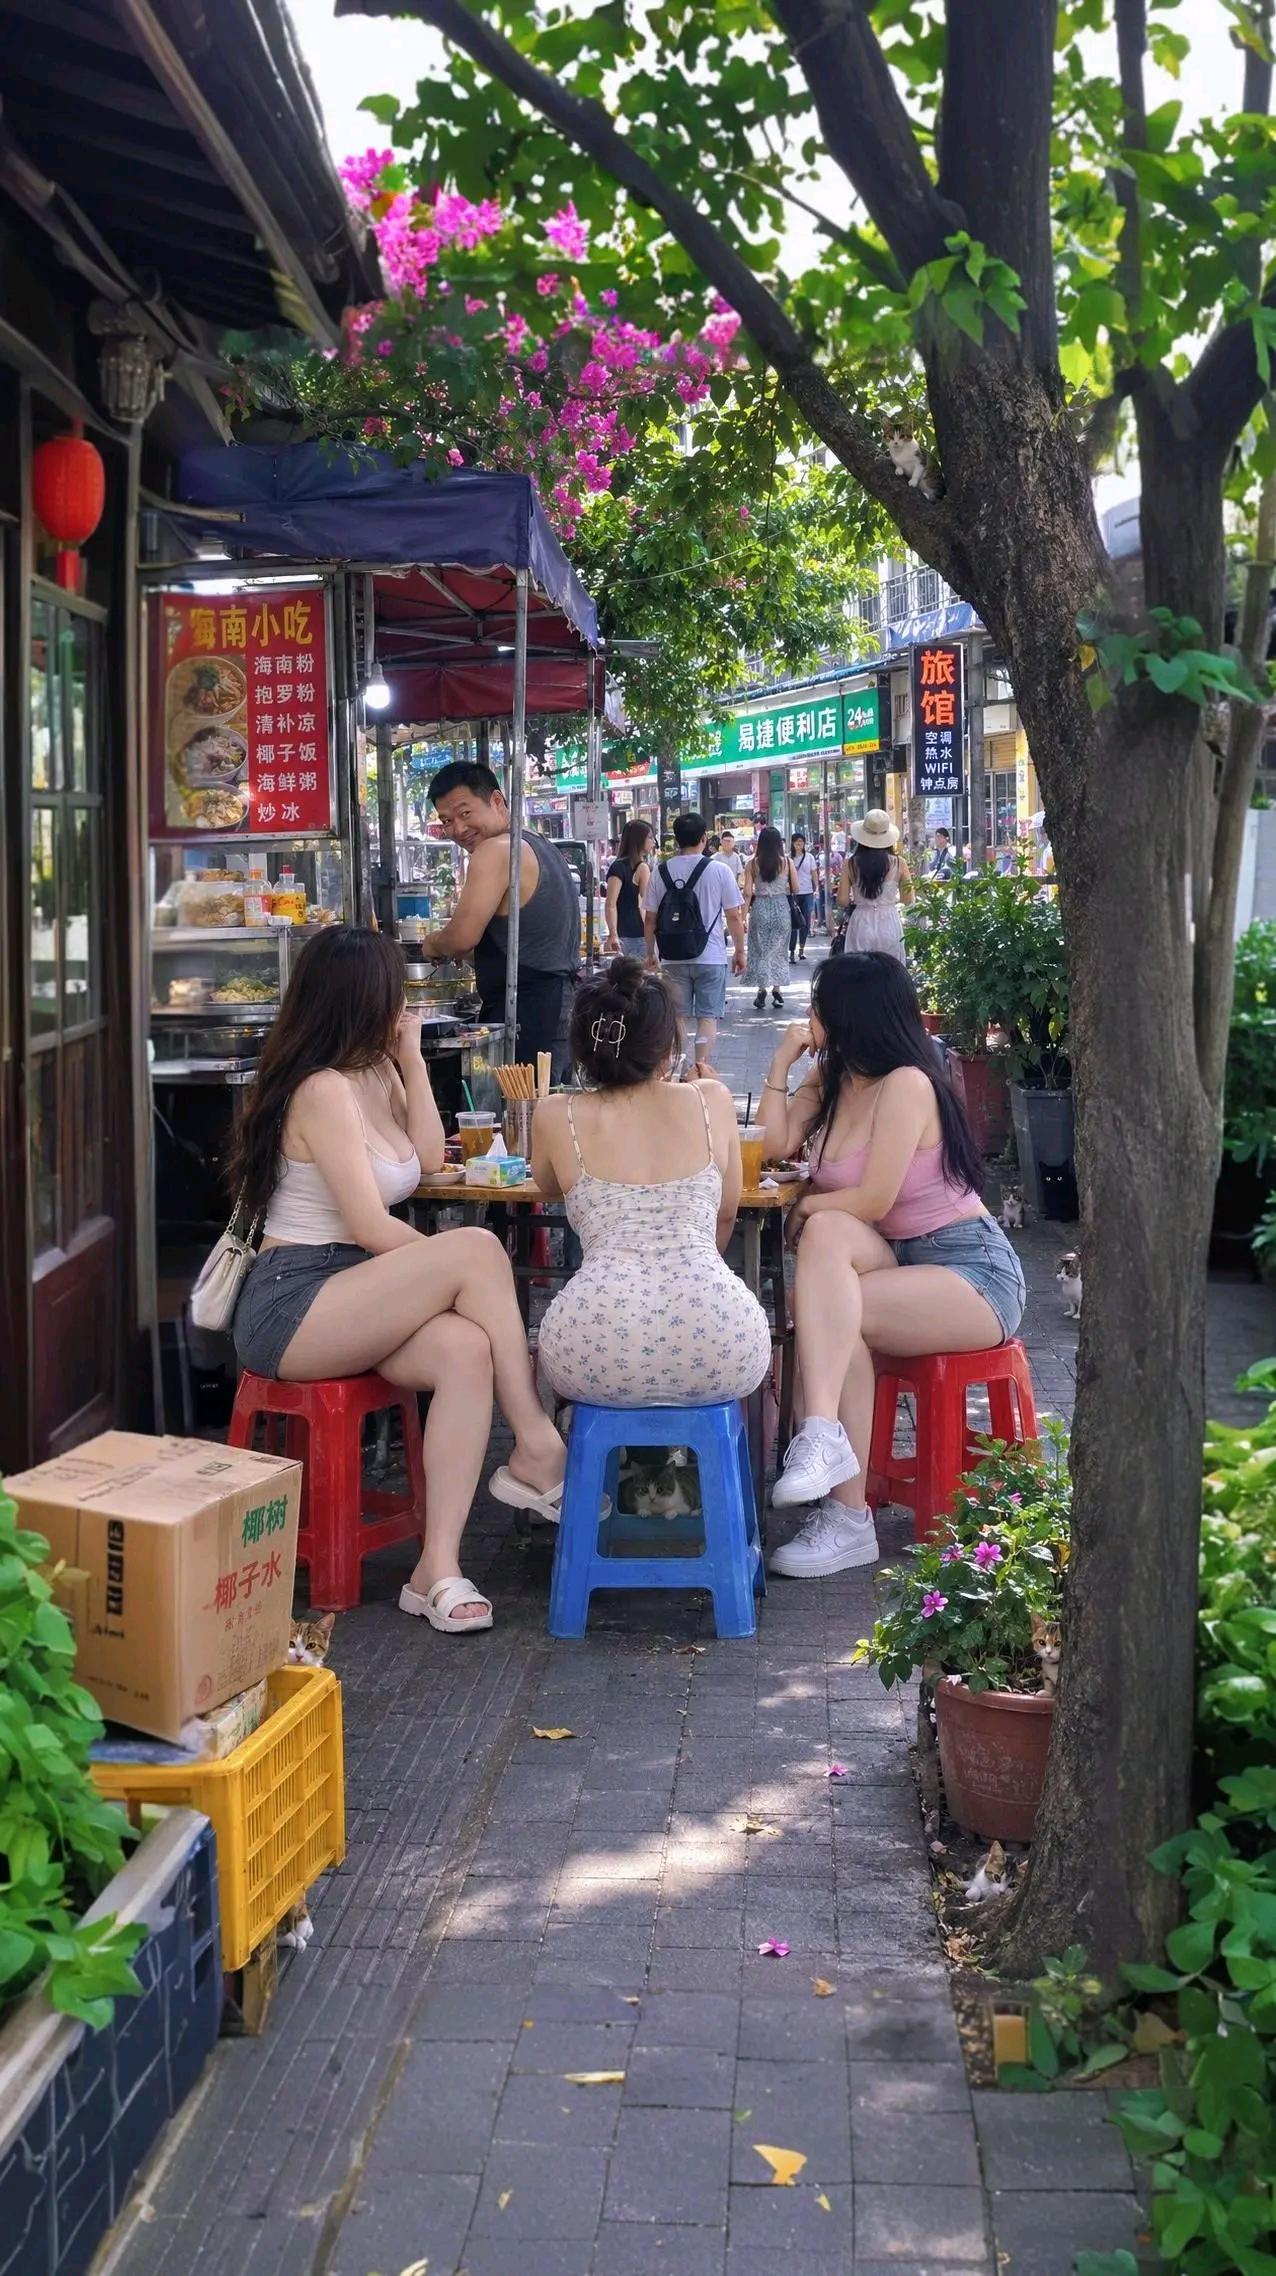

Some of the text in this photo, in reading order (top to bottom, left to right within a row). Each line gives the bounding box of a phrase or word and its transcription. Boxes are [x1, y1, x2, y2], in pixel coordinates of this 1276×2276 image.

[254, 653, 315, 675] 海南粉
[255, 683, 315, 704] 抱罗粉
[920, 650, 955, 725] 旅馆
[256, 712, 316, 734] 清补凉
[925, 731, 952, 745] 空调
[256, 742, 317, 764] 椰子饭
[925, 747, 953, 760] 热水
[924, 762, 953, 774] WIFI
[257, 772, 317, 792] 海鲜粥
[920, 777, 959, 791] 钟点房
[257, 802, 300, 823] 炒冰
[241, 1494, 289, 1549] 椰树
[213, 1550, 282, 1614] 椰子水
